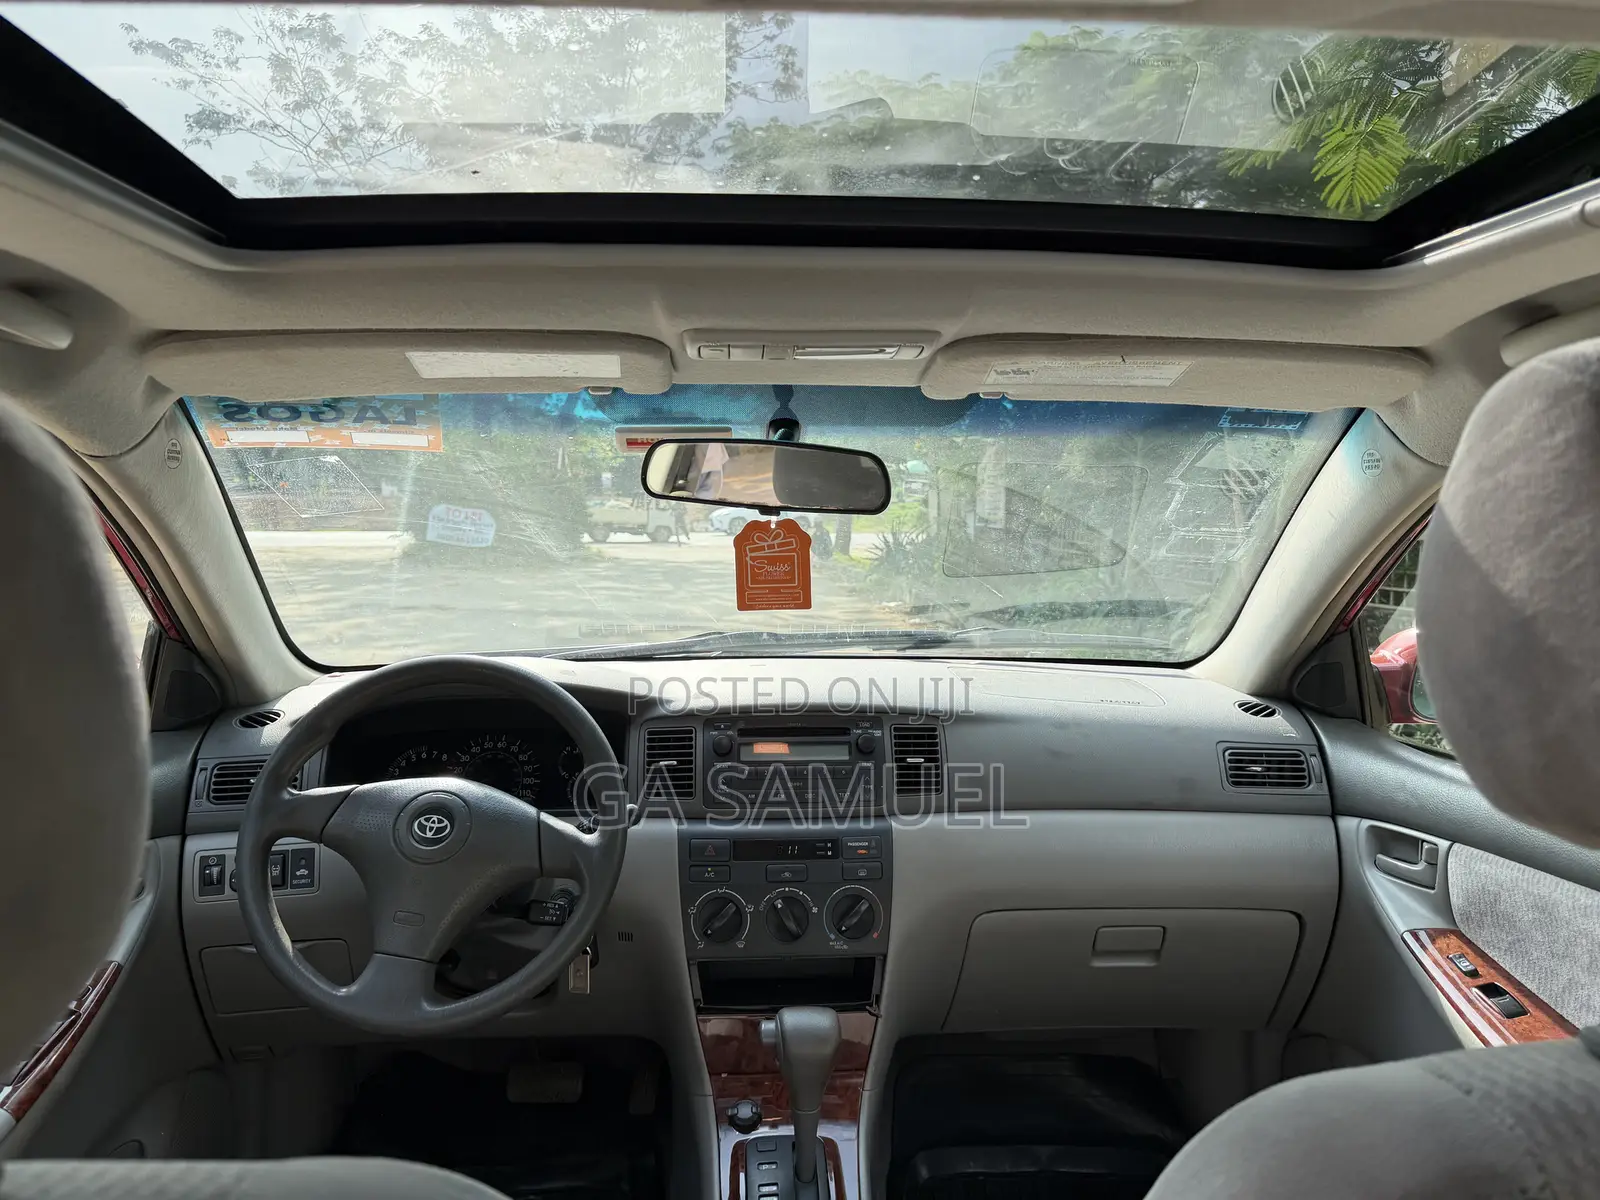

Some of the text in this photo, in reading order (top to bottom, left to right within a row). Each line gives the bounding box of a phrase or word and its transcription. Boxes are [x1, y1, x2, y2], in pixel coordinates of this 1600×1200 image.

[754, 559, 792, 573] Swiss
[509, 745, 519, 753] 70
[411, 754, 417, 762] 5
[421, 750, 427, 759] 6
[432, 750, 438, 758] 7
[441, 753, 448, 761] 8
[393, 768, 399, 776] 3
[453, 766, 463, 774] 20
[519, 789, 531, 797] 110
